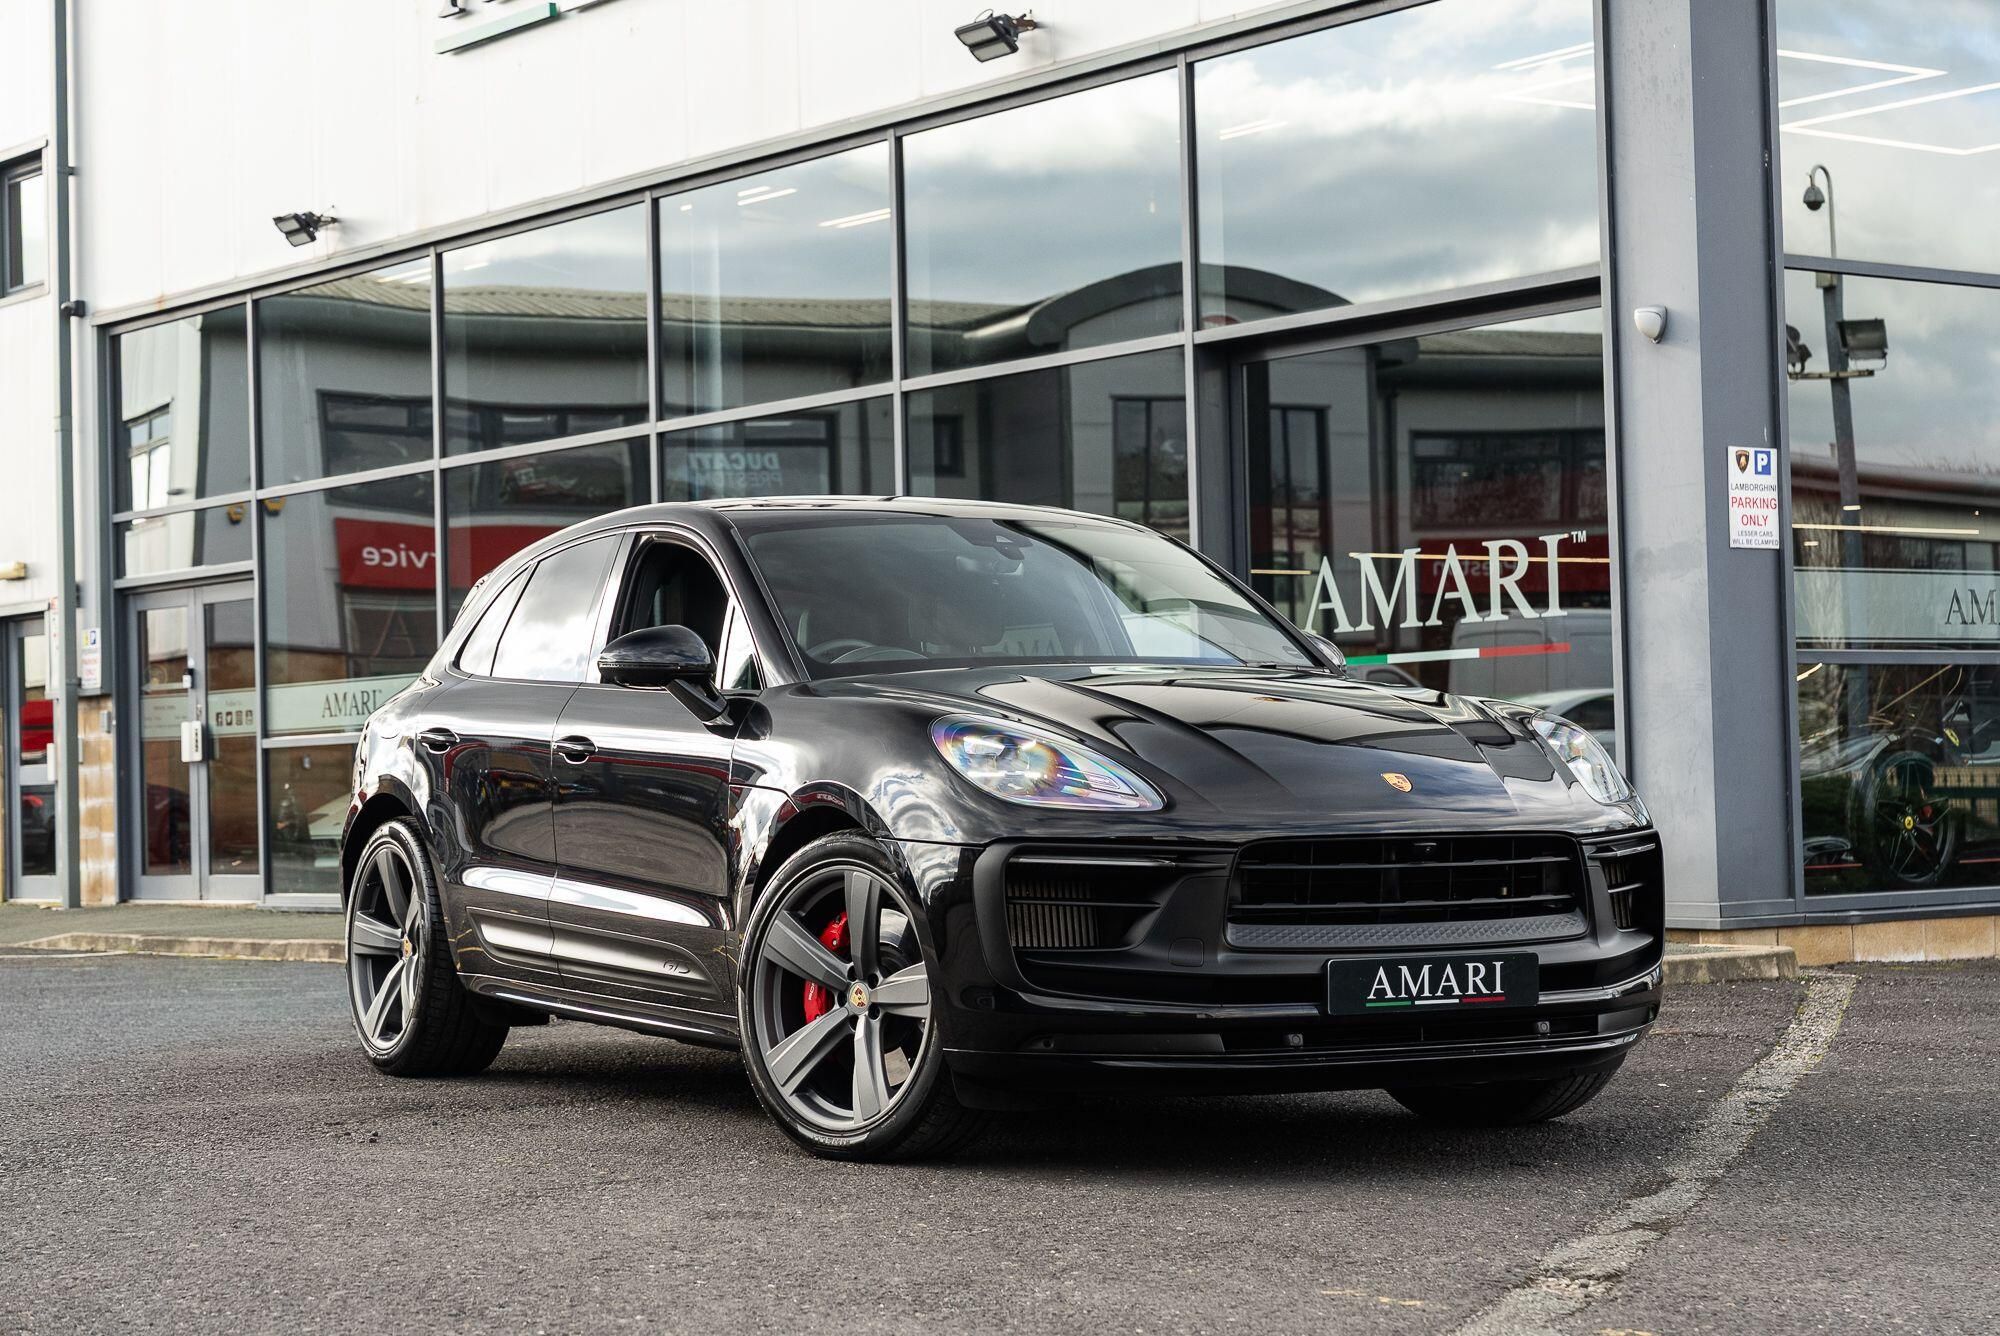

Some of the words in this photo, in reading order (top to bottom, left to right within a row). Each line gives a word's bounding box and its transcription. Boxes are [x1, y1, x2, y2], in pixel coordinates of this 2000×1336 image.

[1757, 453, 1769, 473] P
[1730, 483, 1777, 492] LAMBORGHINI
[1731, 496, 1777, 510] PARKING
[1741, 514, 1768, 526] ONLY
[1302, 533, 1569, 633] AMARI
[1944, 588, 2000, 625] AM
[322, 689, 377, 718] AMARI
[1367, 961, 1504, 999] AMARI
